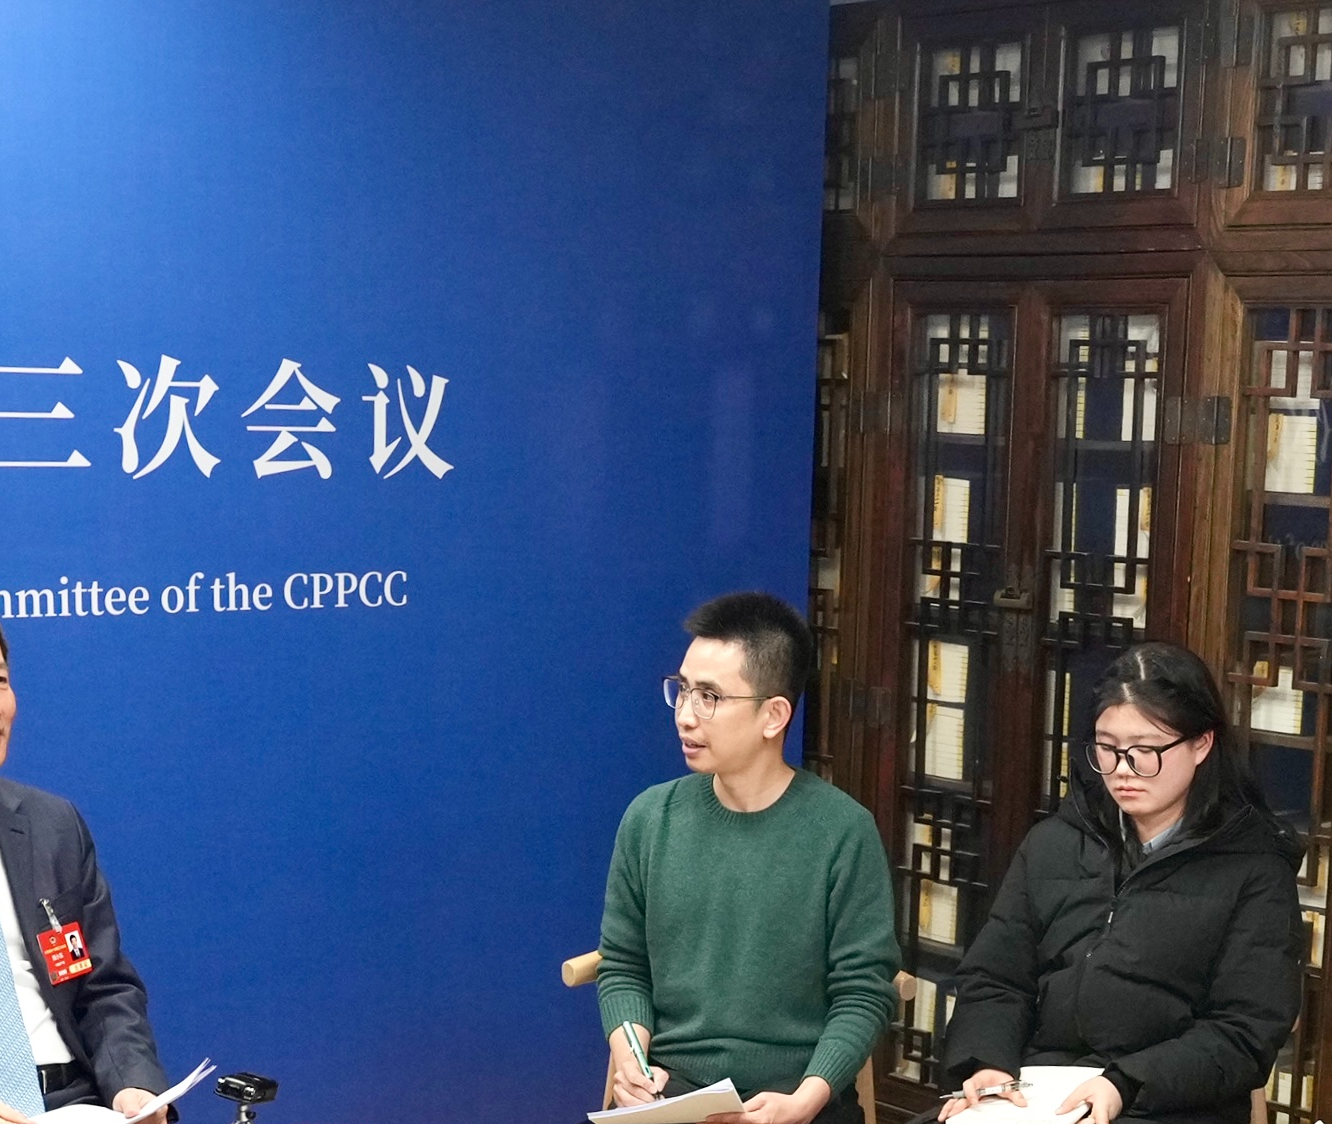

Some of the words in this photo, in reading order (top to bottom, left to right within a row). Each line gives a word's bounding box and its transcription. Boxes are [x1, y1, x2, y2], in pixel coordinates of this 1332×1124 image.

[161, 571, 205, 614] of
[210, 571, 273, 612] the
[283, 570, 407, 610] CPPCC
